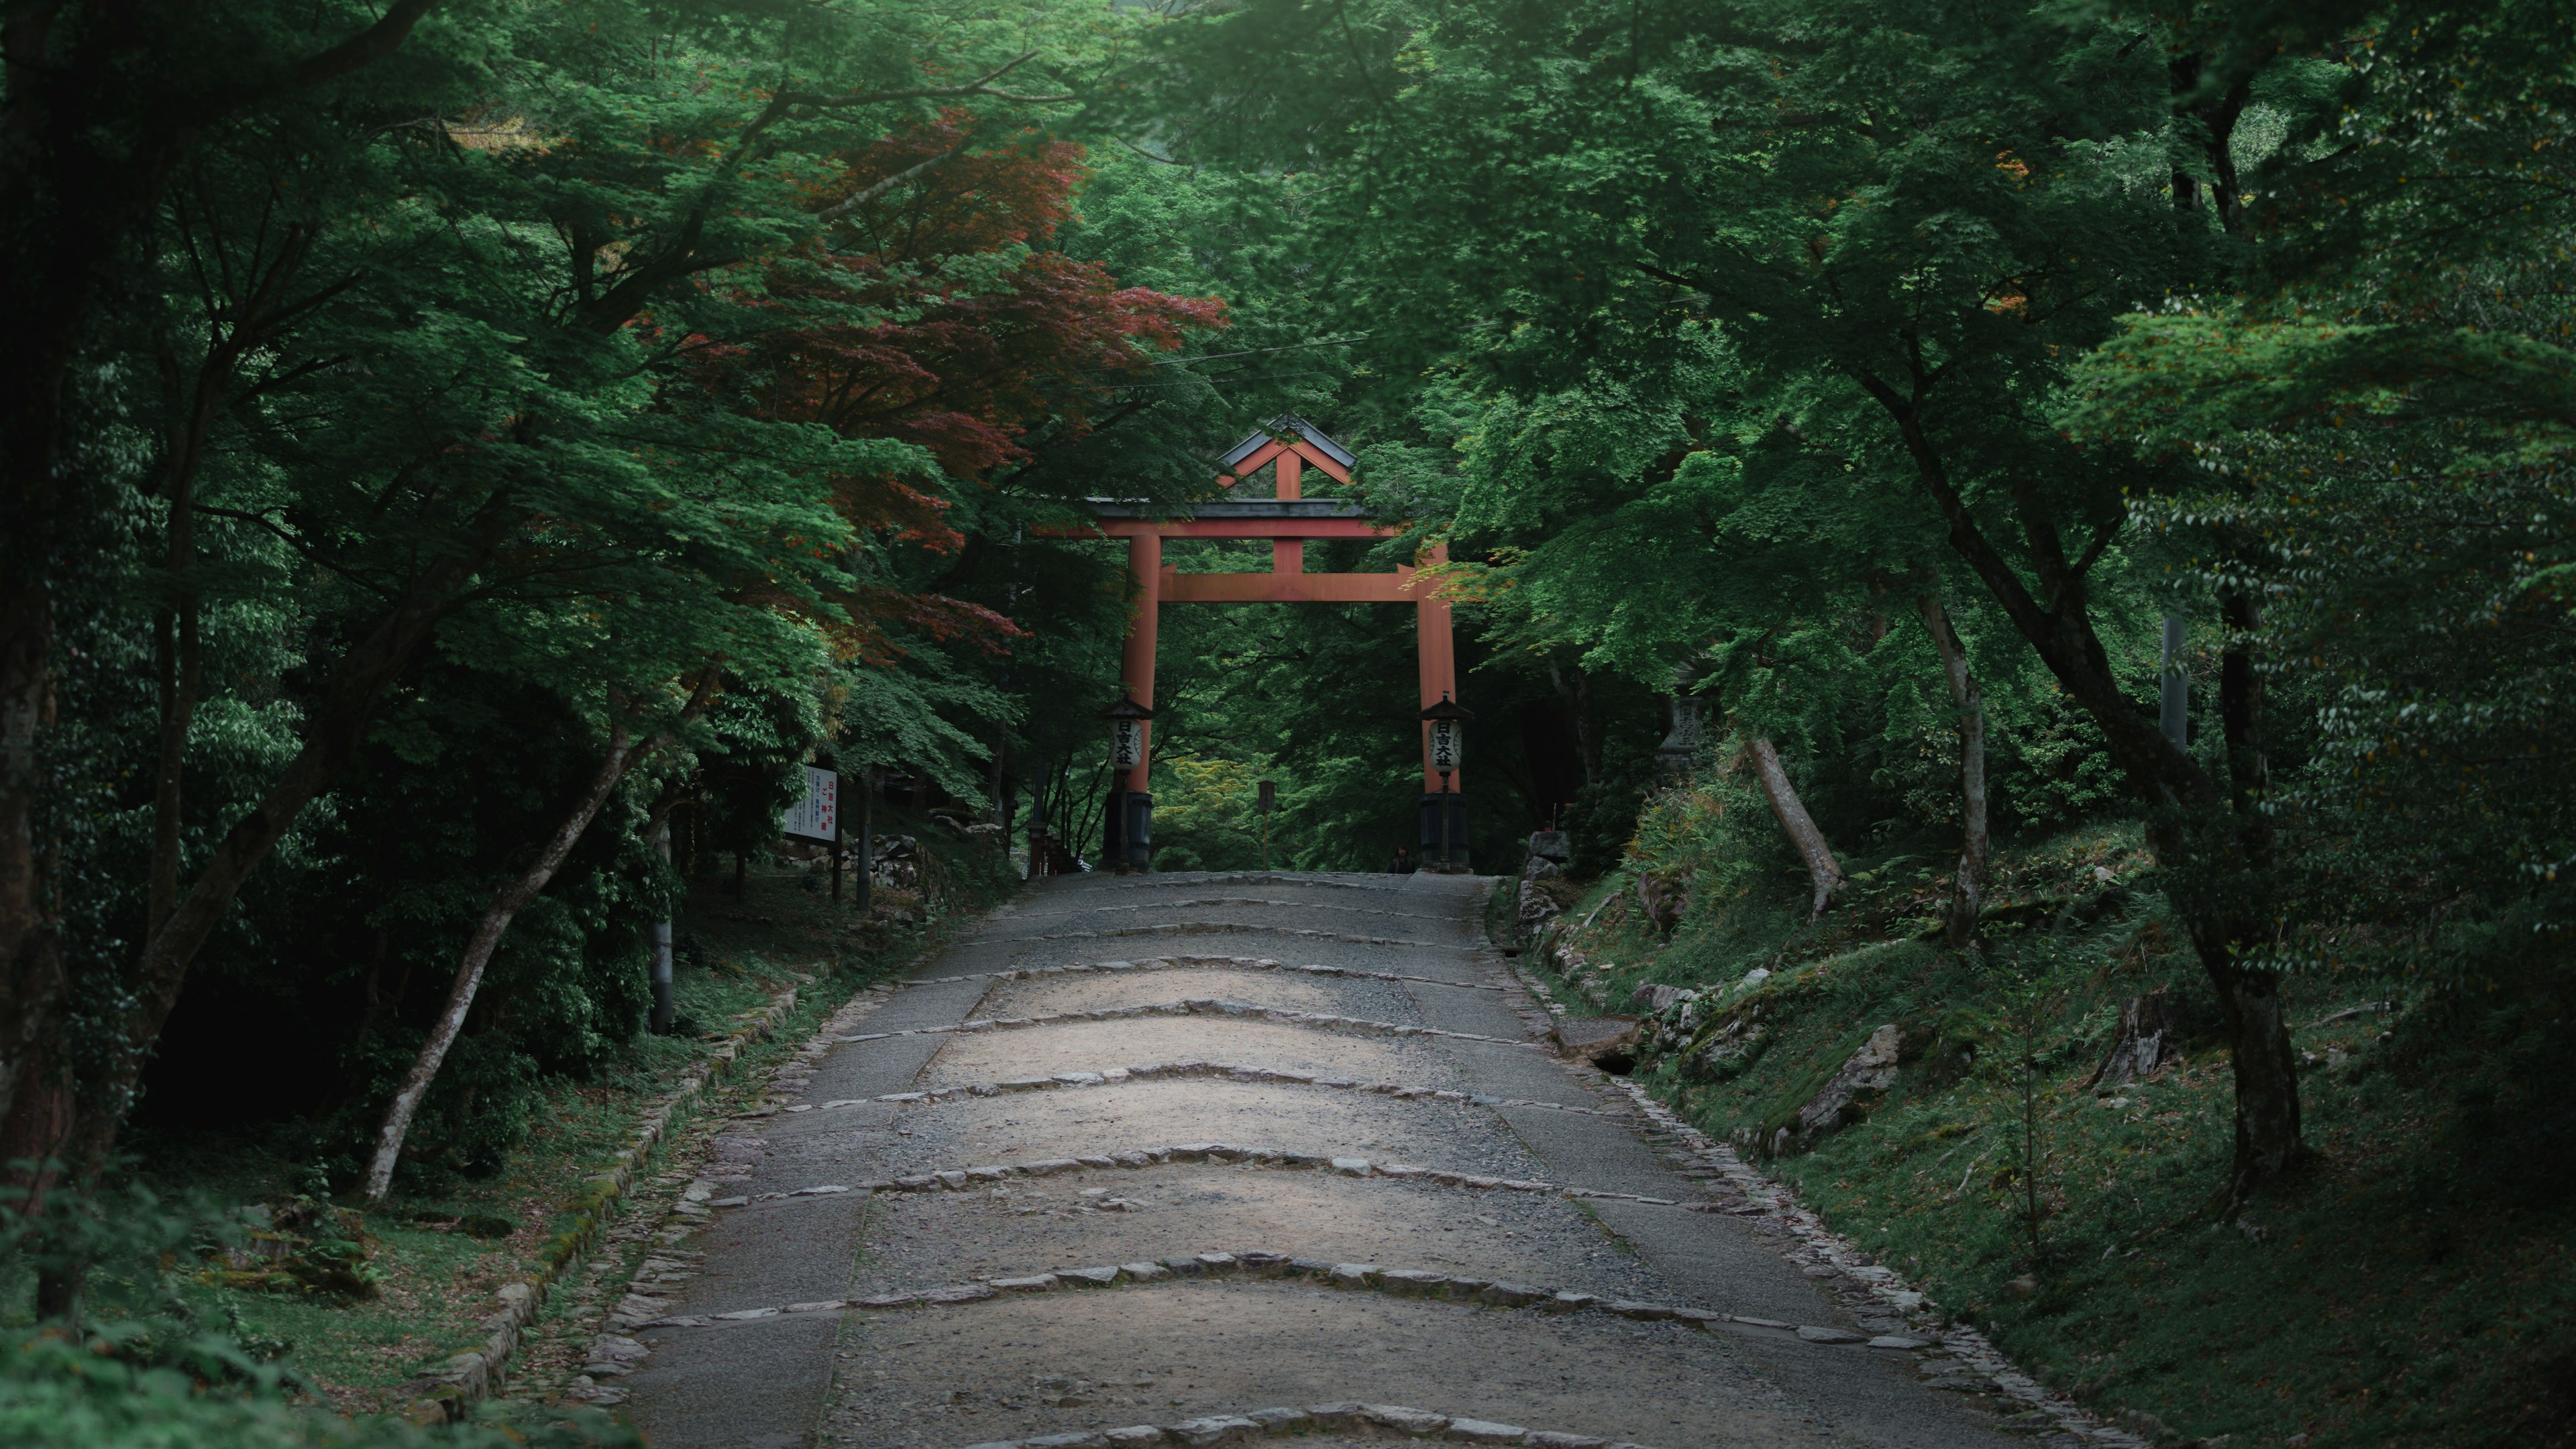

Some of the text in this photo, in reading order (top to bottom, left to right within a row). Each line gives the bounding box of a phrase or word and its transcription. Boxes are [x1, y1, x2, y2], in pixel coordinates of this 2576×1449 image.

[1116, 721, 1133, 765] 日吉大社
[1436, 722, 1452, 767] 日吉大社
